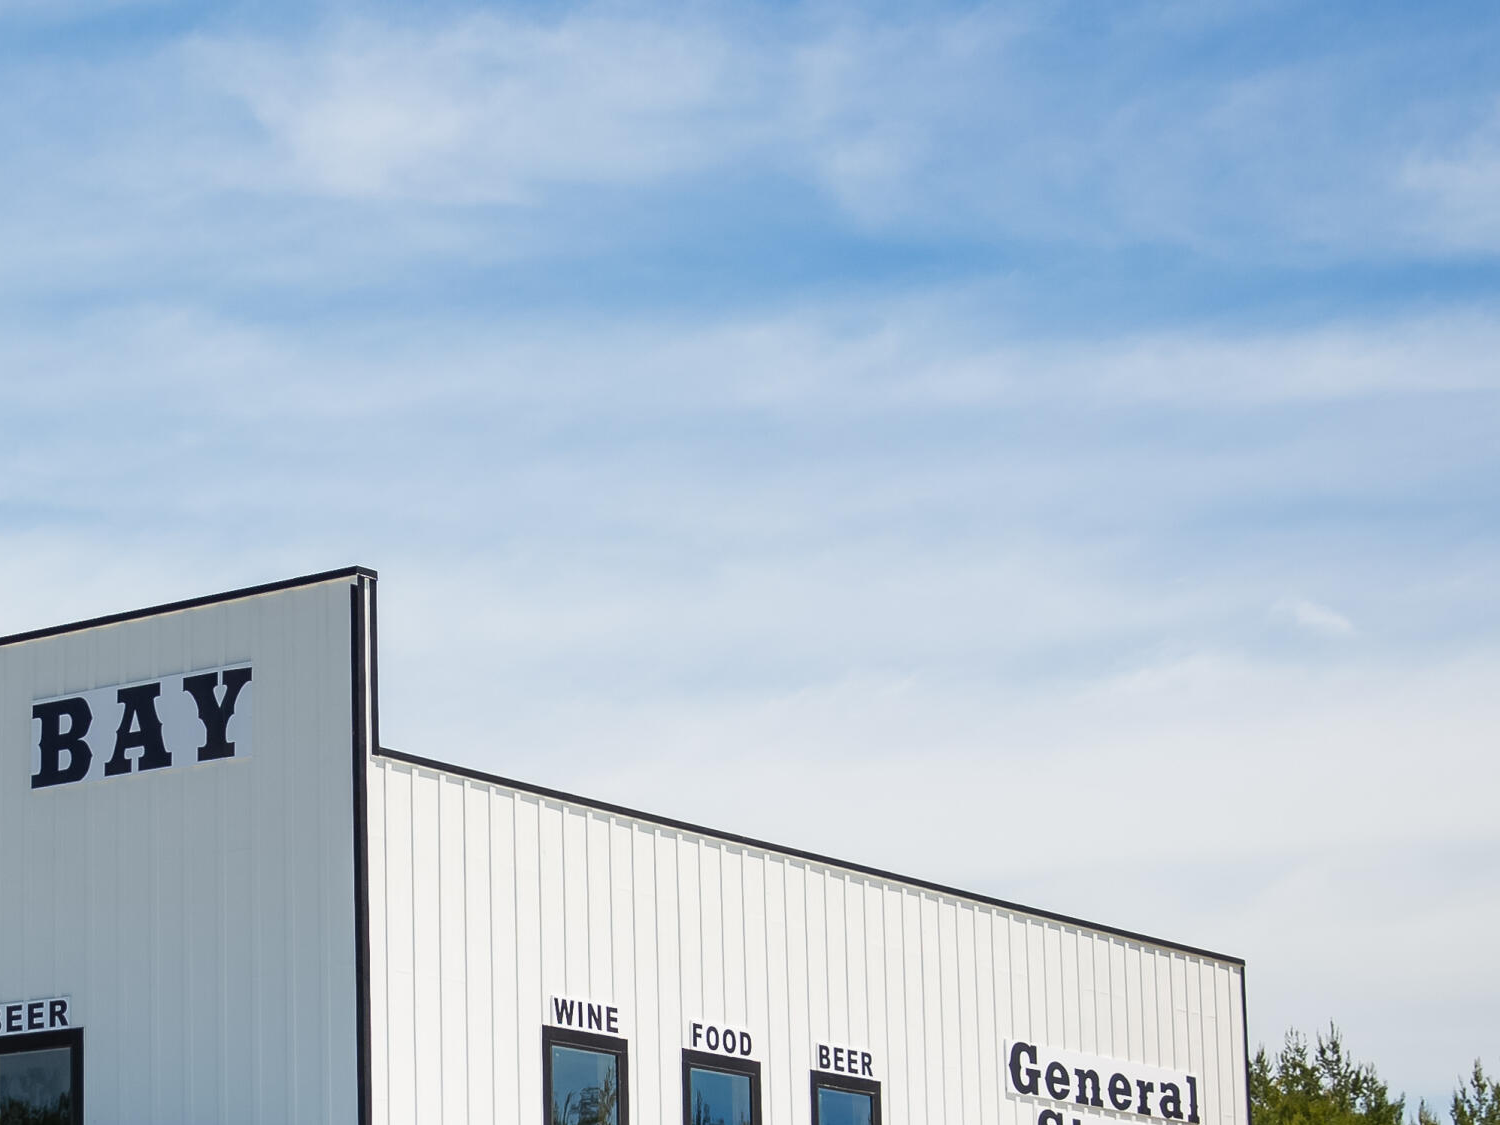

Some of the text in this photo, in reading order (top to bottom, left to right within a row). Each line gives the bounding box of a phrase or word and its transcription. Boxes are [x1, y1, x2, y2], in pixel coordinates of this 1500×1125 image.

[31, 667, 252, 790] BAY
[554, 997, 619, 1034] WINE
[692, 1022, 753, 1057] FOOD
[818, 1044, 873, 1077] BEER
[1008, 1041, 1200, 1124] General
